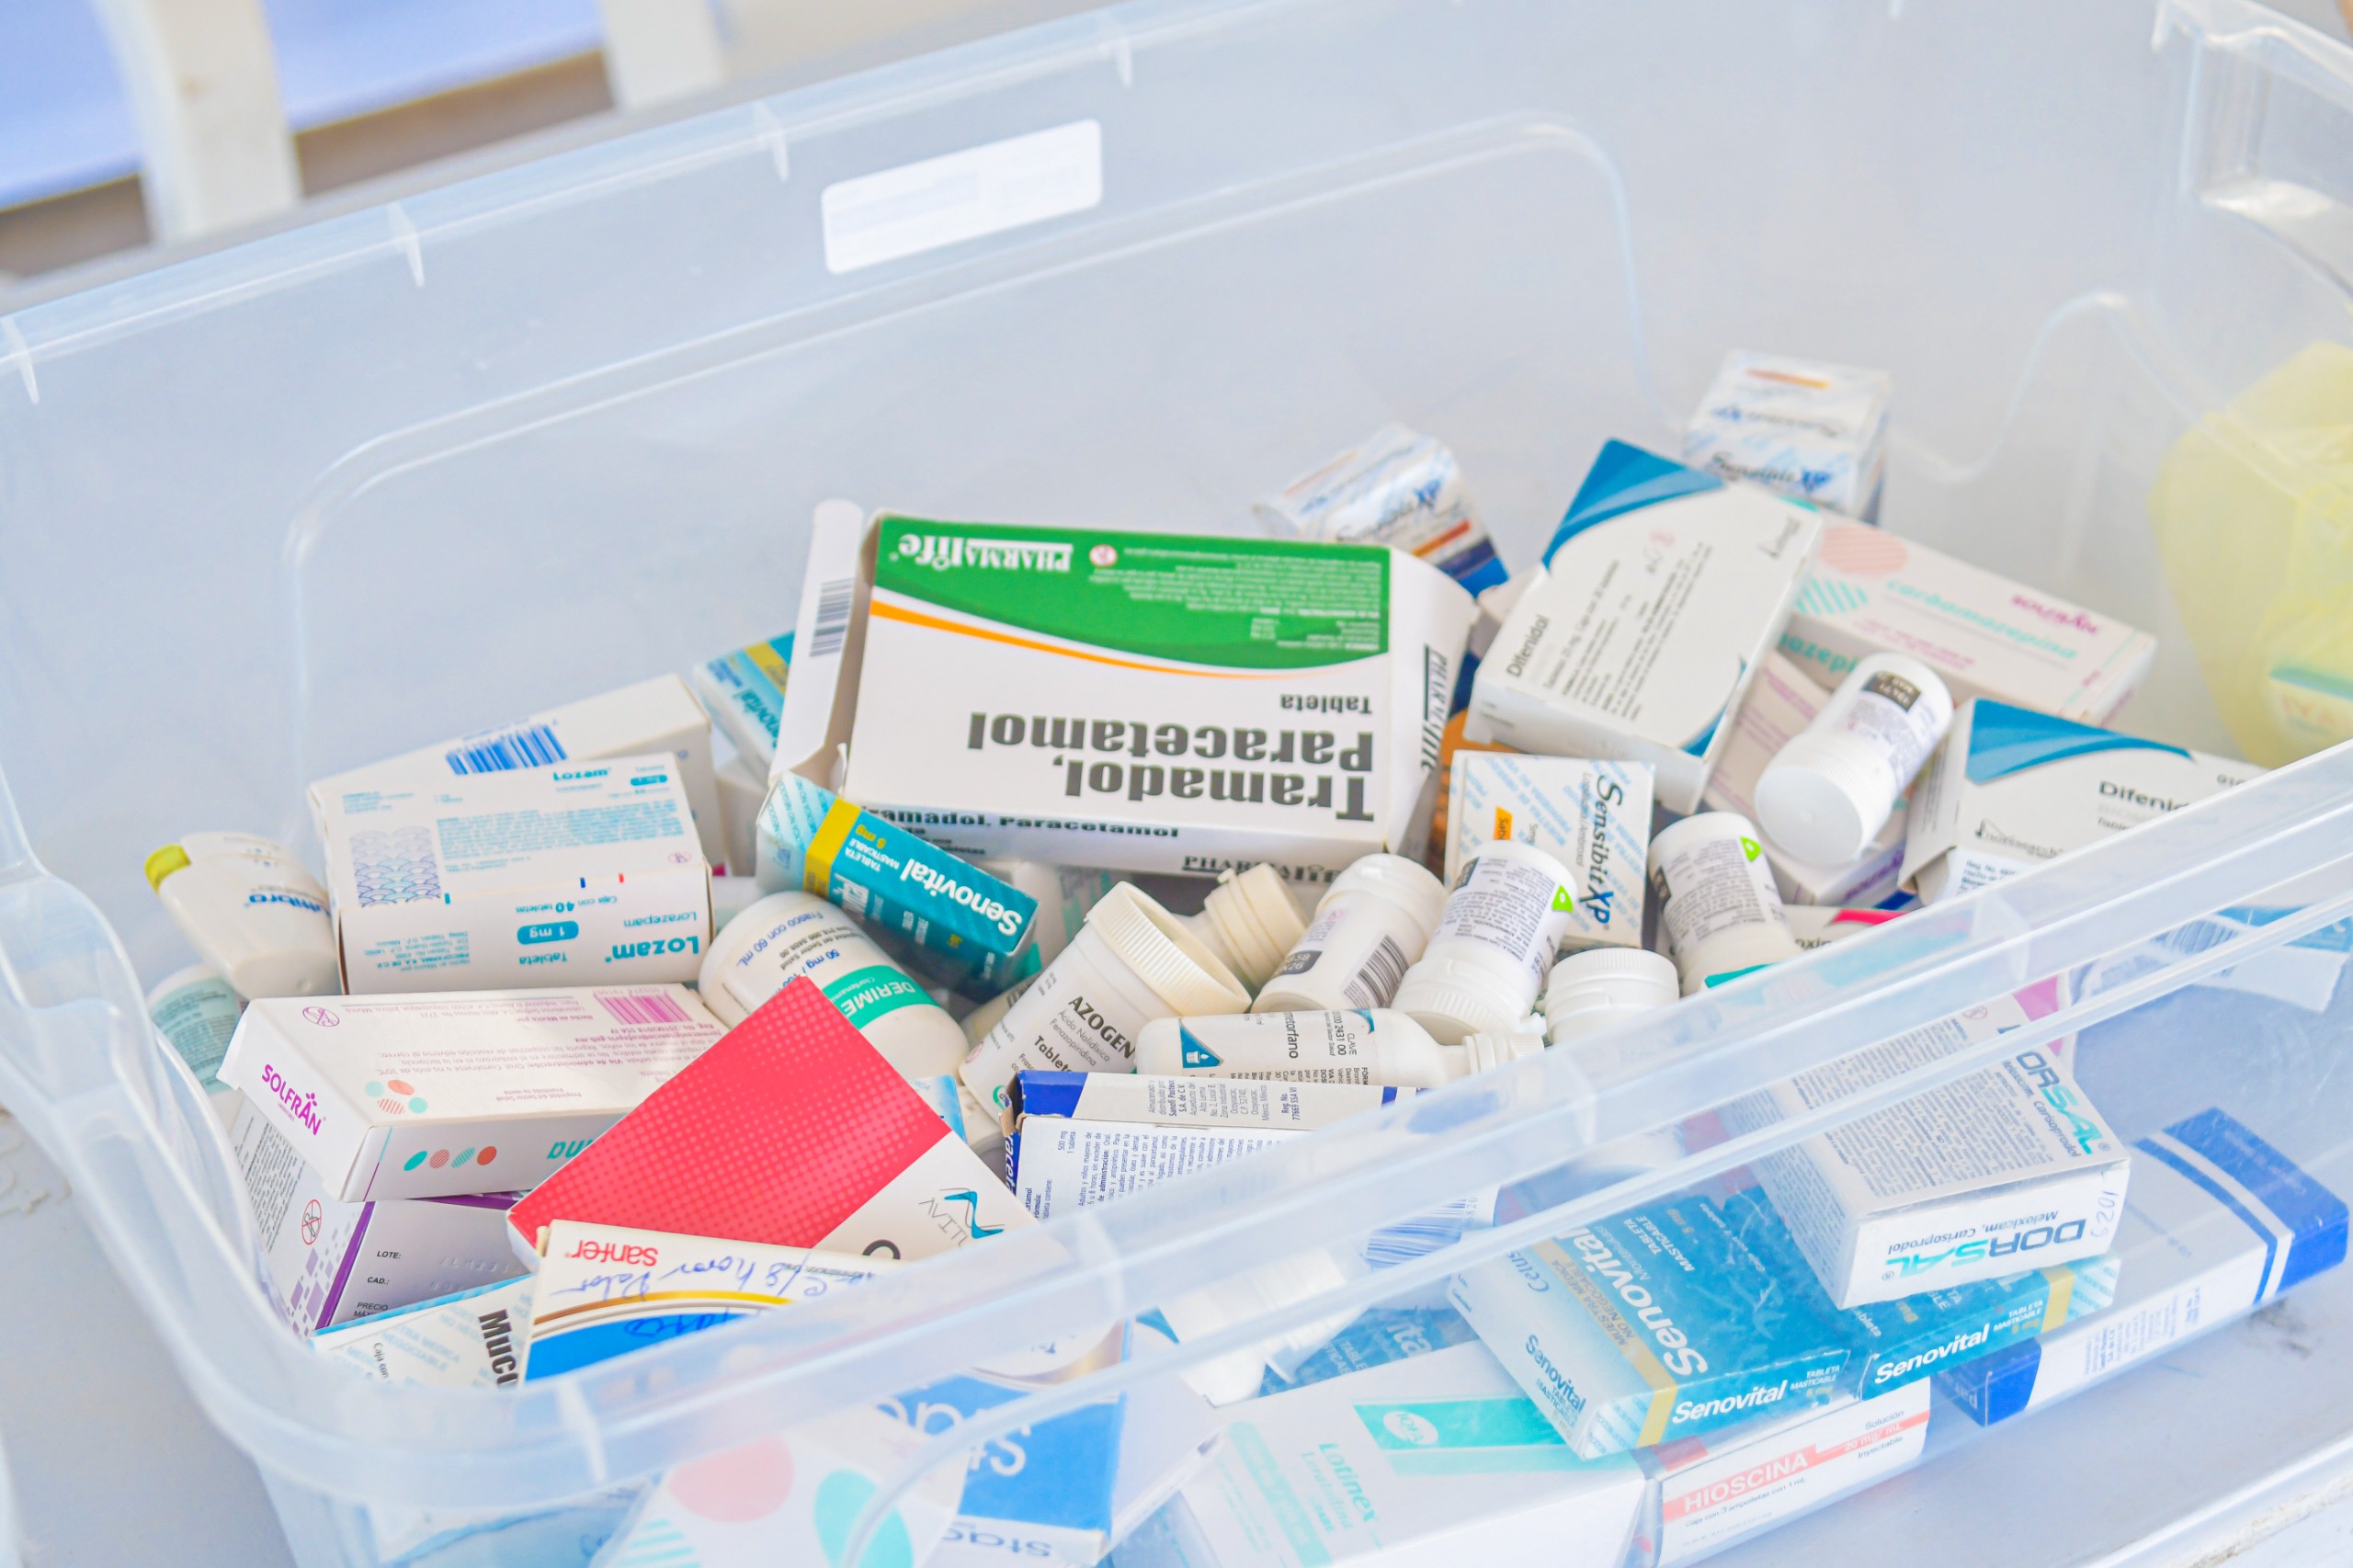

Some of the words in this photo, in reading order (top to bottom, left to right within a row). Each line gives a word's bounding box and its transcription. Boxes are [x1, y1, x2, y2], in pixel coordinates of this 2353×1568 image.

[1506, 614, 1550, 678] Difenidol
[1280, 695, 1373, 714] Tableta
[967, 711, 1373, 772] Paracetamol
[1051, 755, 1374, 822] Tramadol,
[999, 816, 1179, 837] Paracetamol
[1589, 774, 1623, 886] Sensibit
[845, 847, 881, 872] TABLETA
[849, 837, 900, 870] MASTICABLE
[555, 902, 574, 913] 40
[900, 858, 1023, 936] Senovital
[559, 926, 565, 937] 1
[623, 911, 697, 928] Lorazepam
[788, 912, 824, 926] Frasco
[529, 927, 552, 938] mg
[770, 925, 787, 939] con
[518, 951, 567, 965] Tableta
[611, 936, 699, 960] Lozam
[754, 938, 768, 953] 60
[825, 949, 840, 960] 50
[805, 955, 825, 970] mg
[1058, 1008, 1076, 1031] Ácido
[1068, 995, 1136, 1059] AZOGEN
[1050, 1018, 1097, 1066] Fenazopiridina
[1347, 1032, 1358, 1056] CLAVE
[1281, 1103, 1290, 1113] Reg.
[2017, 1051, 2103, 1155] ORSAL
[2032, 1100, 2081, 1158] Carisoprodol
[1078, 1187, 1086, 1206] Adultos
[1084, 1142, 1092, 1163] mayores
[1097, 1149, 1108, 1192] administración:
[1982, 1210, 2059, 1234] Meloxicam,
[1623, 1219, 1663, 1256] TABLETA
[1636, 1215, 1696, 1273] MASTICABLE
[1885, 1219, 2087, 1278] DORSAL
[1887, 1226, 1976, 1256] Carisoprodol
[377, 1250, 402, 1260] LOTE:
[572, 1240, 658, 1267] sanfer
[367, 1276, 390, 1286] CAD.:
[357, 1301, 389, 1312] PRECIO
[1557, 1227, 1709, 1377] Senovital
[2007, 1299, 2044, 1318] TABLETA
[1875, 1324, 1990, 1384] Senovital
[1993, 1308, 2042, 1332] MASTICABLE
[1525, 1334, 1587, 1415] Senovital
[1805, 1365, 1841, 1380] TABLETA
[1671, 1379, 1789, 1425] Senovital
[1790, 1372, 1839, 1392] MASTICABLE
[1865, 1409, 1904, 1431] Solución
[1857, 1435, 1904, 1460] Inyectable
[1683, 1451, 1809, 1515] HIOSCINA
